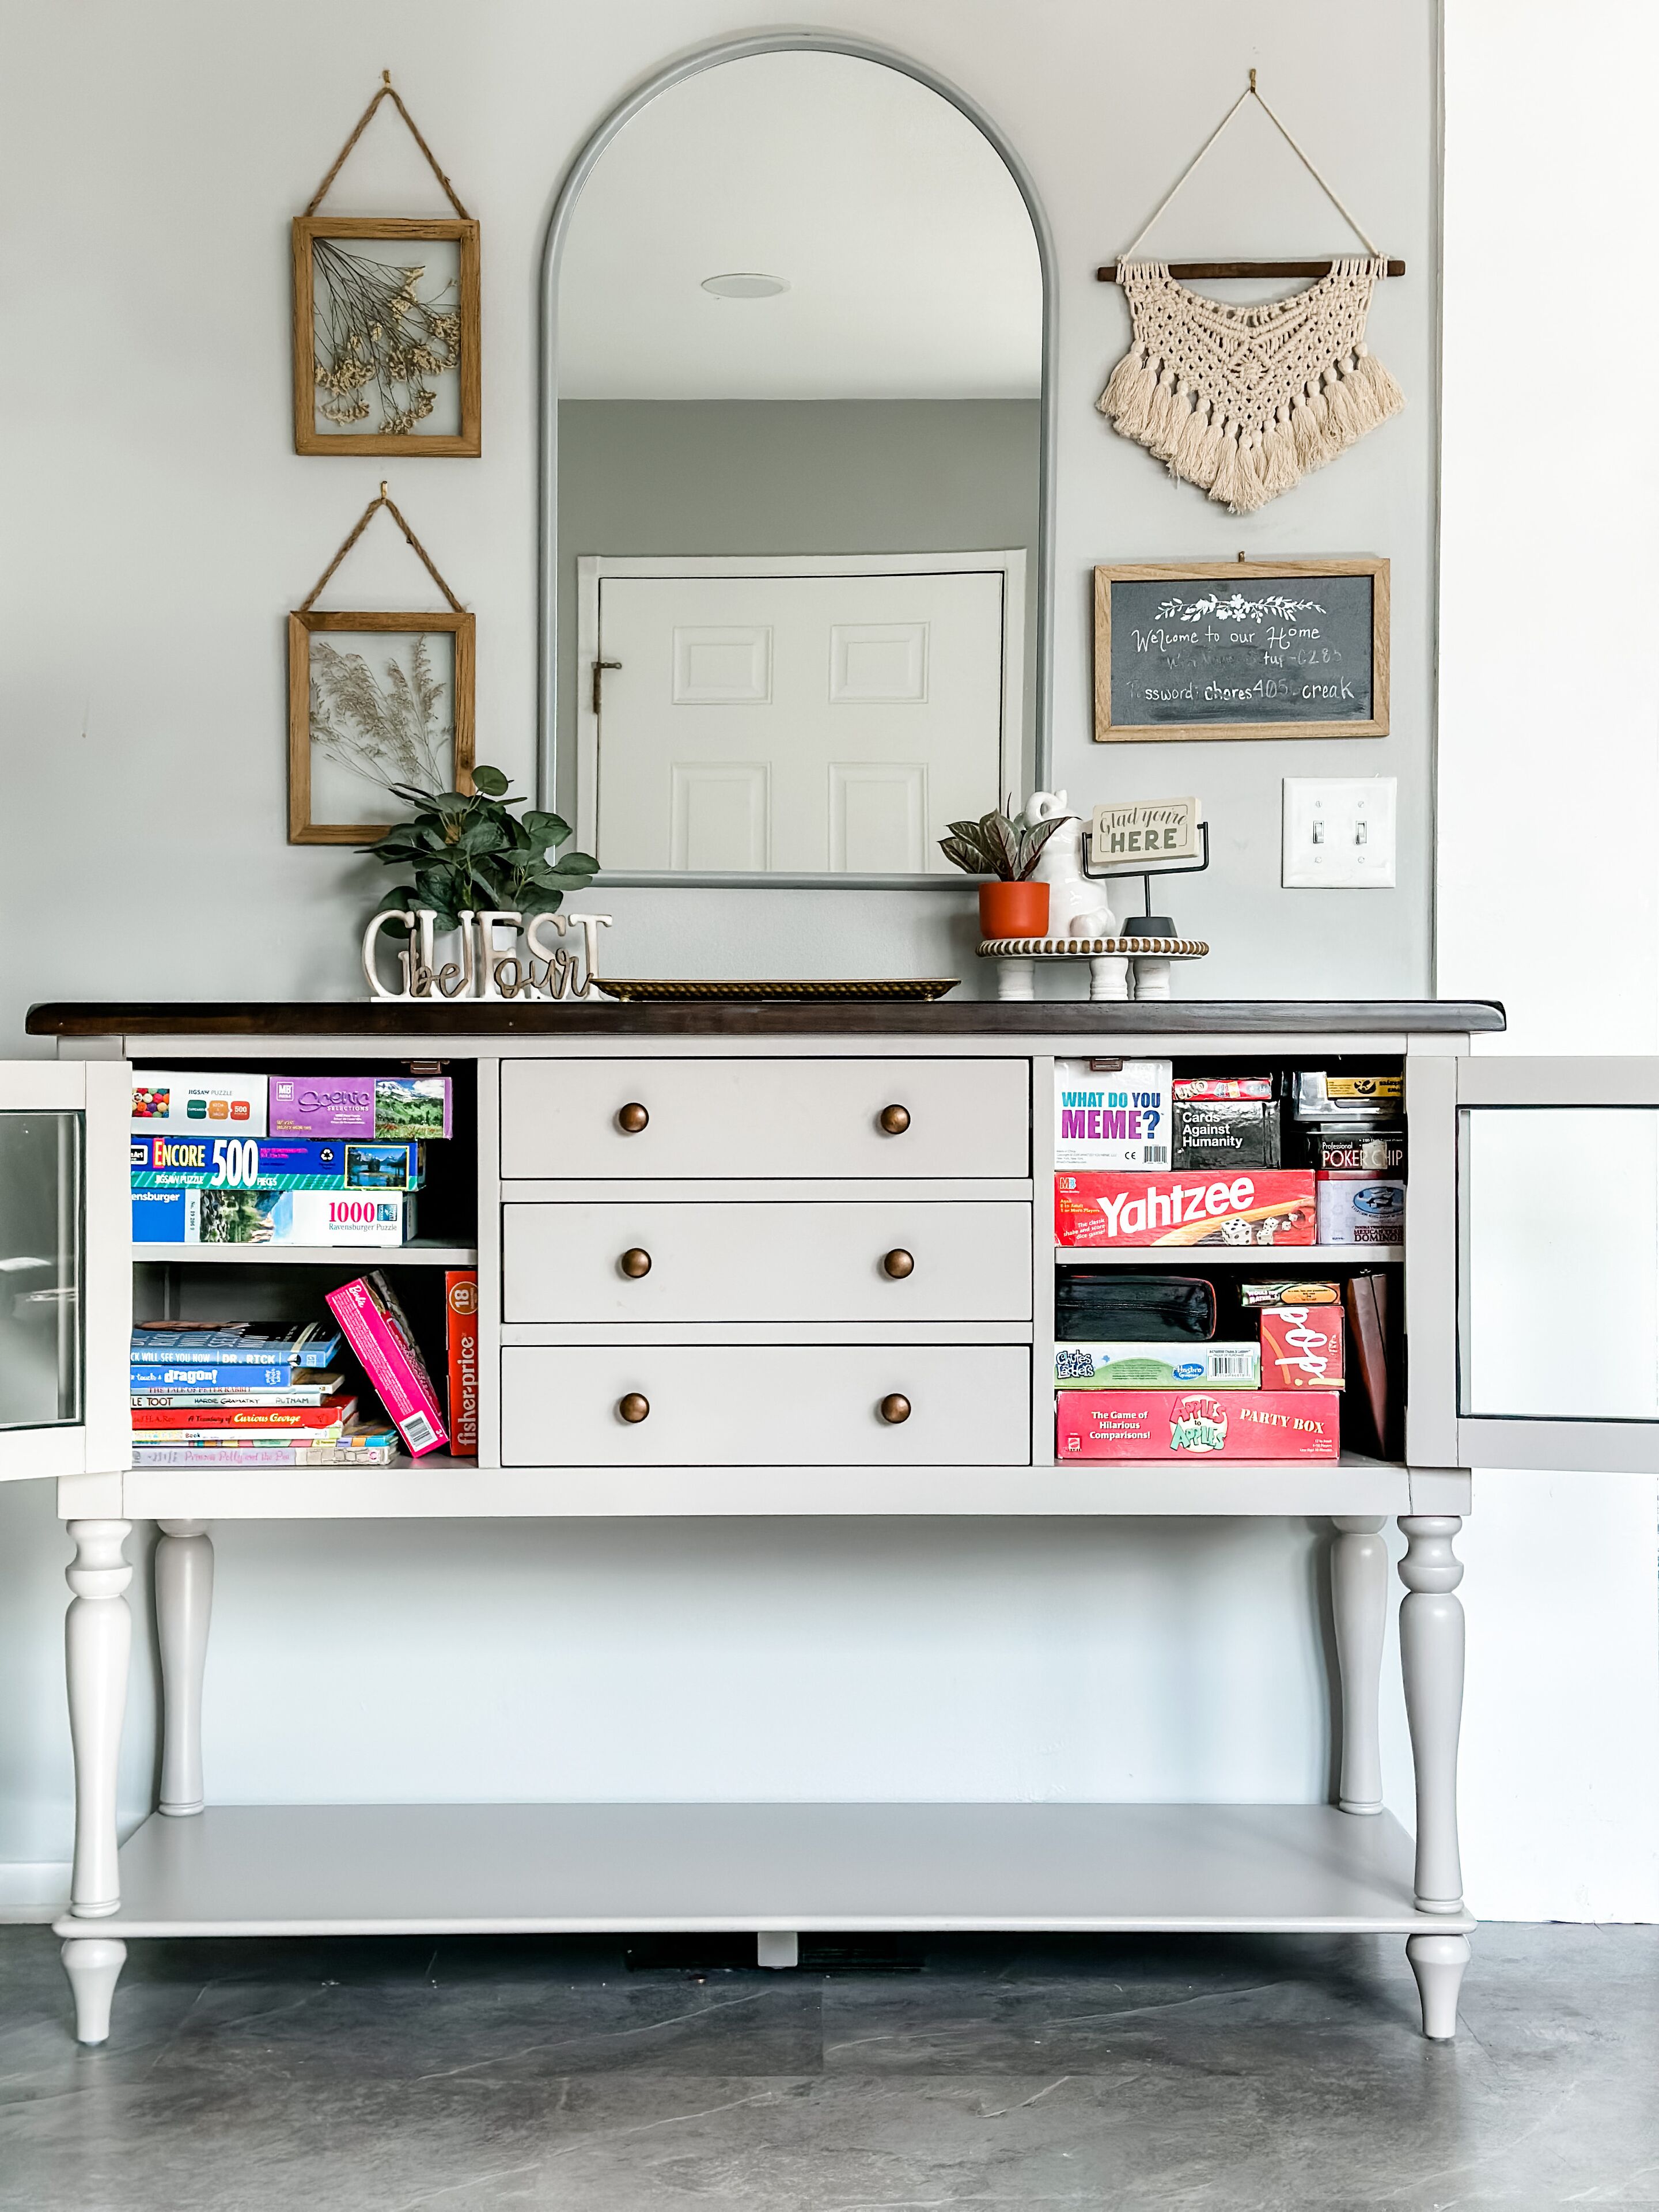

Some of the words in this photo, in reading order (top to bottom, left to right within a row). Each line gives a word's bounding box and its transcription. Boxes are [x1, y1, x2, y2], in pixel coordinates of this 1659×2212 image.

[1131, 630, 1199, 652] Welcome
[1205, 626, 1220, 643] to
[1230, 632, 1255, 643] our
[1266, 626, 1321, 650] Home
[1100, 807, 1139, 836] Glad
[1111, 828, 1177, 853] HERE
[408, 929, 468, 998] be
[494, 948, 594, 999] our
[298, 1090, 370, 1112] Scenic
[1062, 1092, 1104, 1108] WHAT
[1108, 1092, 1128, 1108] DO
[1132, 1092, 1161, 1108] YOU
[1062, 1110, 1161, 1139] MEME?
[1182, 1112, 1221, 1123] Cards
[1183, 1124, 1231, 1137] Against
[1183, 1136, 1243, 1149] Humanity
[1322, 1142, 1353, 1151] Professional
[154, 1141, 206, 1167] ENCORE
[210, 1139, 259, 1187] 500
[1323, 1150, 1368, 1167] POKER
[155, 1175, 180, 1184] JIGSAW
[180, 1175, 203, 1184] PUZZLE
[1060, 1177, 1076, 1189] MB
[131, 1192, 180, 1203] ensburger
[328, 1202, 375, 1222] 1000
[1096, 1177, 1255, 1238] Yahtzee
[329, 1224, 374, 1232] Ravensburger
[349, 1284, 367, 1308] Barbie
[454, 1289, 469, 1308] 18
[131, 1352, 139, 1362] CK
[141, 1353, 160, 1362] WILL
[161, 1354, 174, 1362] SEE
[175, 1354, 190, 1362] YOU
[193, 1354, 210, 1362] NOW
[222, 1354, 243, 1363] DR.
[246, 1354, 276, 1364] RICK
[1056, 1350, 1092, 1365] Chutes
[136, 1373, 157, 1381] touch
[164, 1369, 218, 1384] dragon!
[1057, 1363, 1094, 1379] Ladders
[457, 1336, 478, 1446] fisher-price
[132, 1397, 142, 1406] LE
[146, 1397, 173, 1406] TOOT
[1170, 1396, 1226, 1423] APPLES
[234, 1413, 268, 1423] Curious
[270, 1413, 301, 1425] George
[1111, 1411, 1136, 1419] Game
[1138, 1411, 1148, 1419] of
[1240, 1408, 1290, 1427] PARTY
[1293, 1418, 1324, 1434] BOX
[1100, 1421, 1140, 1429] Hilarious
[1089, 1430, 1150, 1441] Comparisons!
[1170, 1423, 1228, 1451] APPLES
